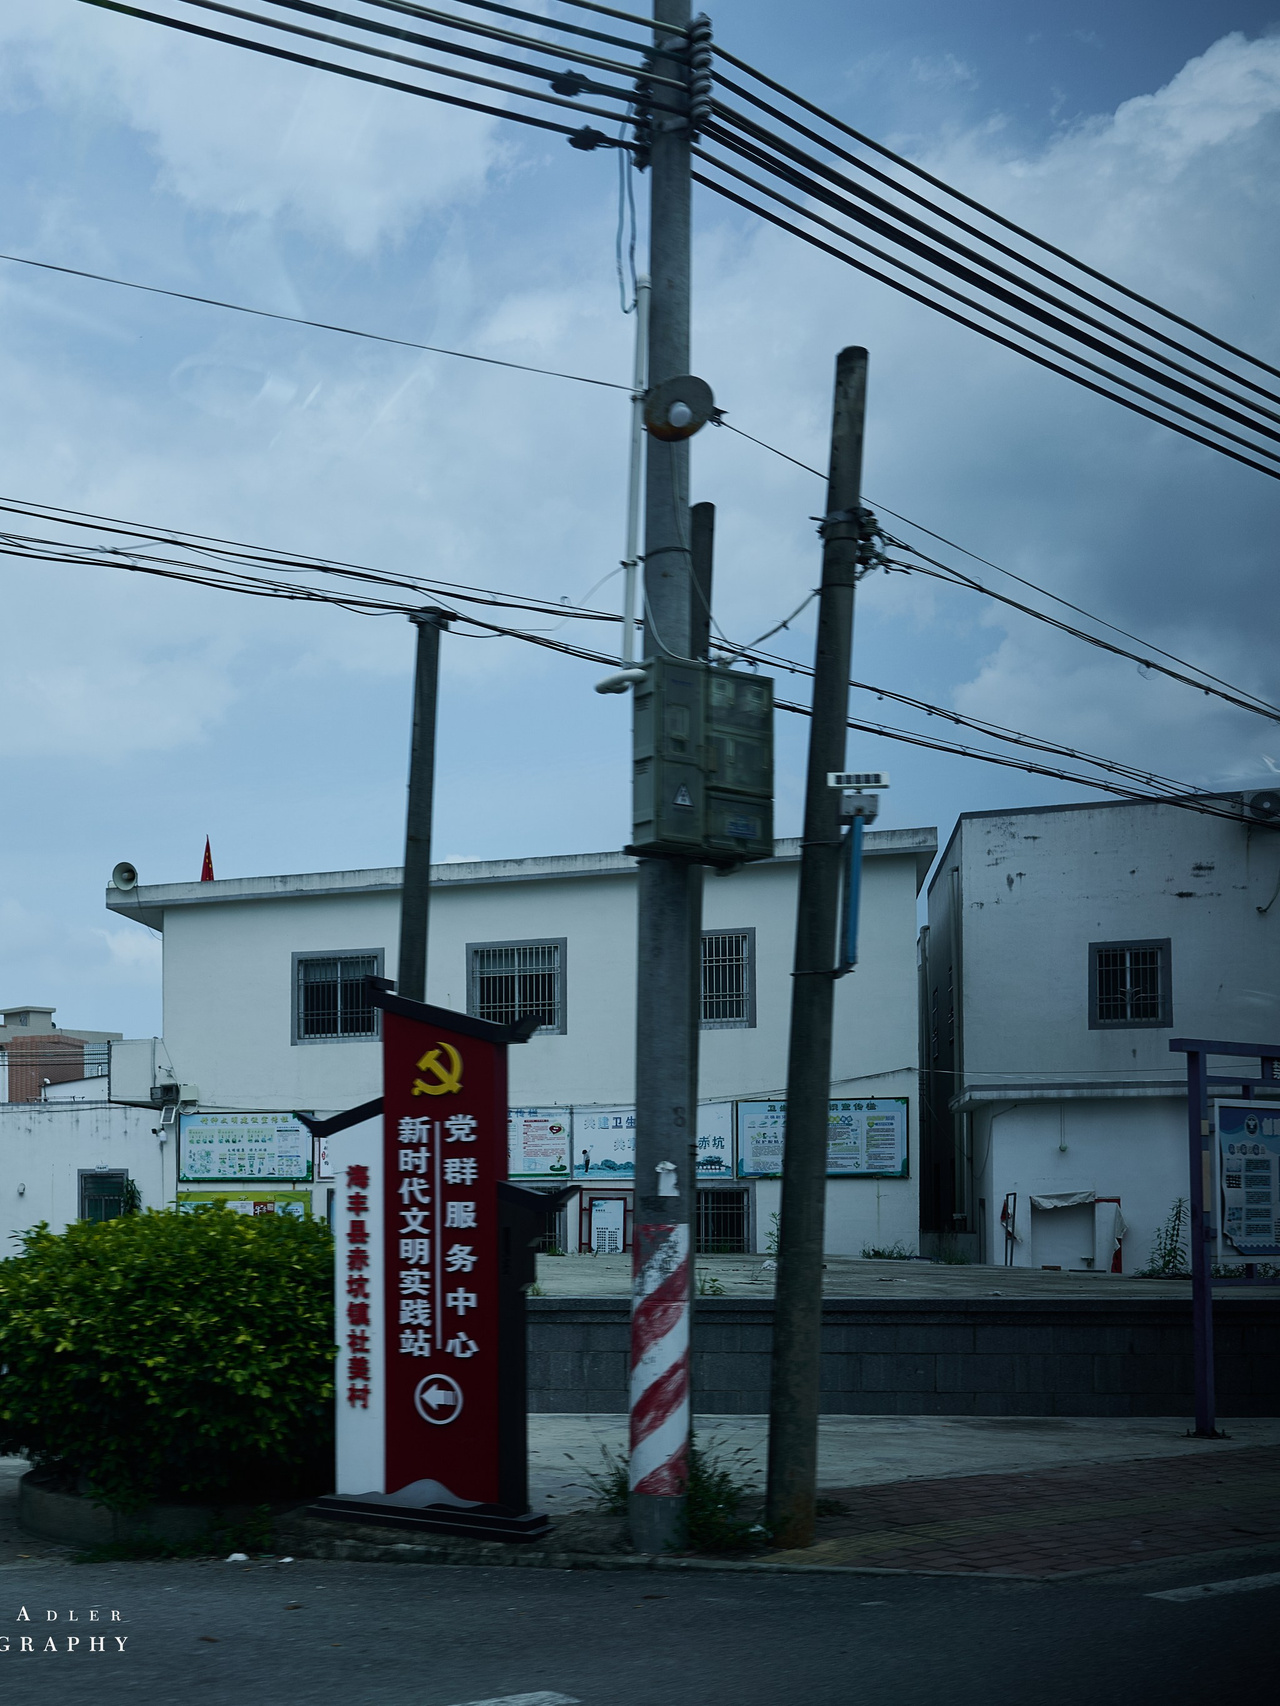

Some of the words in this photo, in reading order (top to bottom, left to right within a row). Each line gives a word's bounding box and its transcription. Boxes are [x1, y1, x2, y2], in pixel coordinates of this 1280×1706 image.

[345, 1164, 371, 1410] 海丰县赤坑镇社美村
[398, 1116, 433, 1358] 新时代文明实践站
[444, 1114, 480, 1359] 党群服务中心
